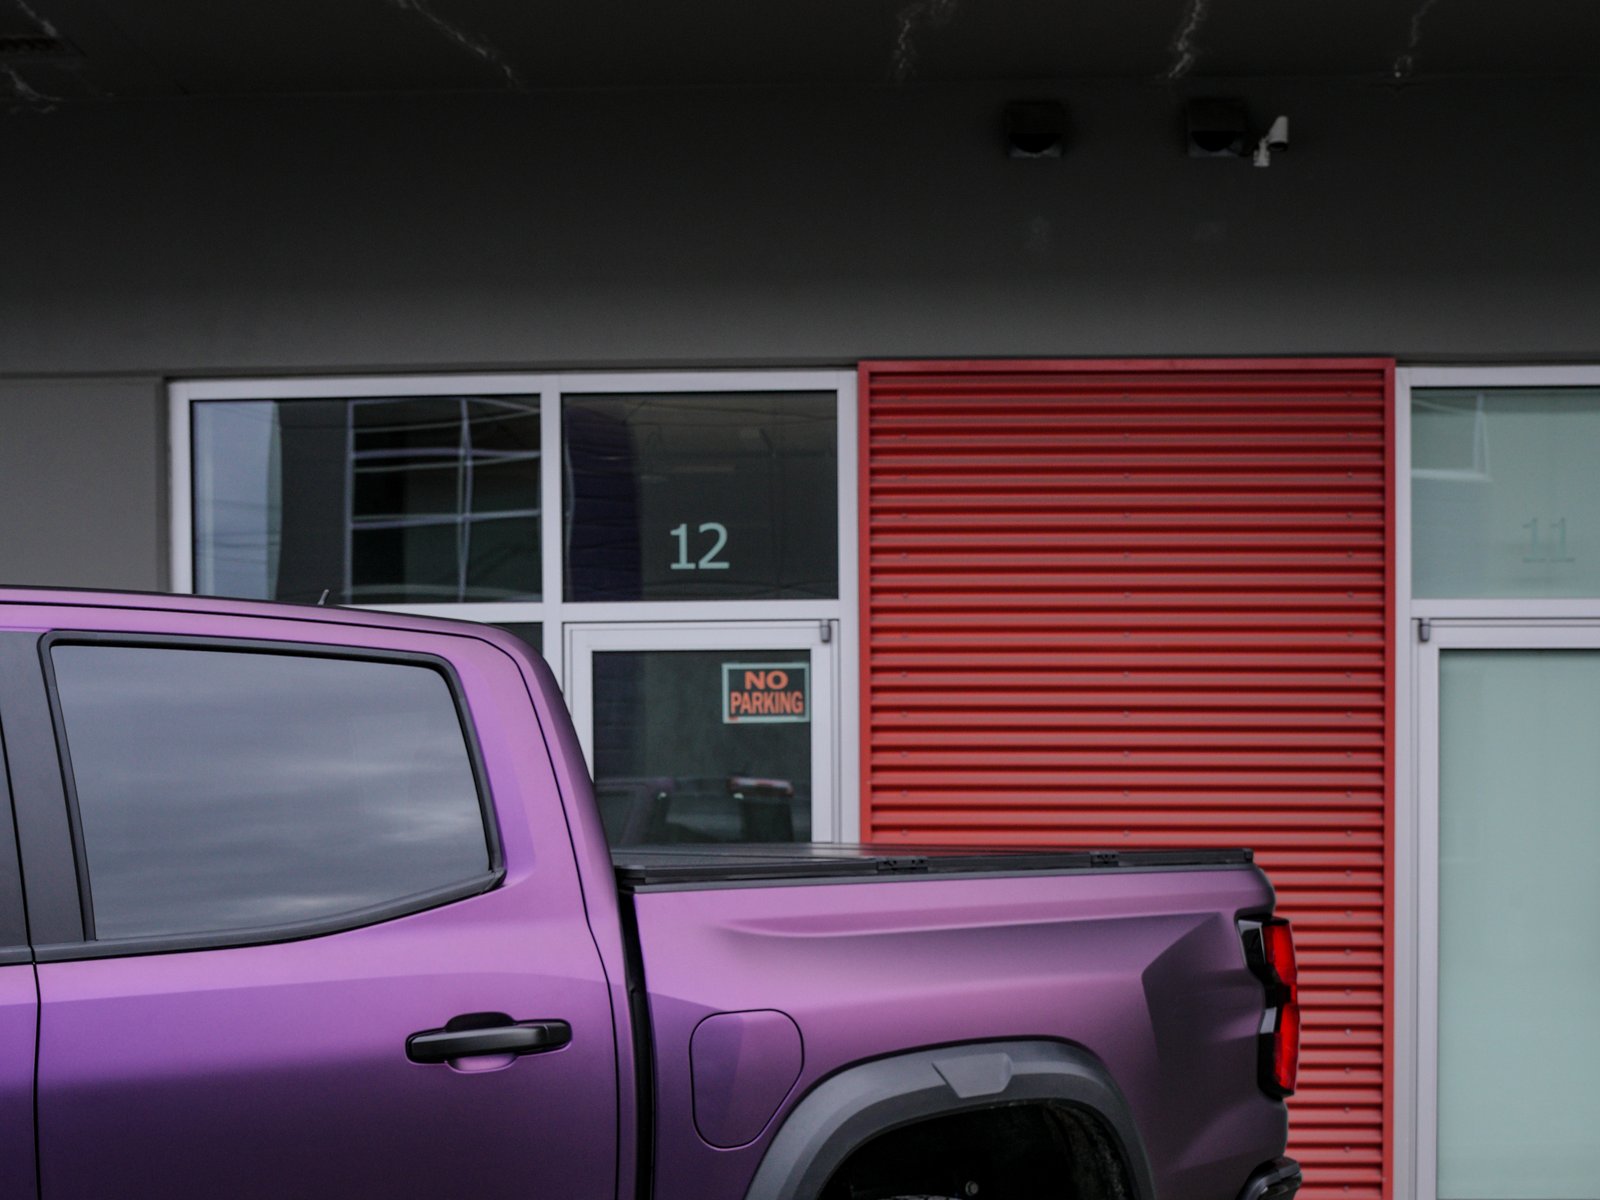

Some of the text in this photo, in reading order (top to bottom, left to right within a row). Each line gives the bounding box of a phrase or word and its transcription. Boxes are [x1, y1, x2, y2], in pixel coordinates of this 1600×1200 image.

[670, 522, 730, 569] 12
[1522, 517, 1575, 563] 11
[745, 671, 789, 690] NO
[730, 691, 804, 714] PARKING
